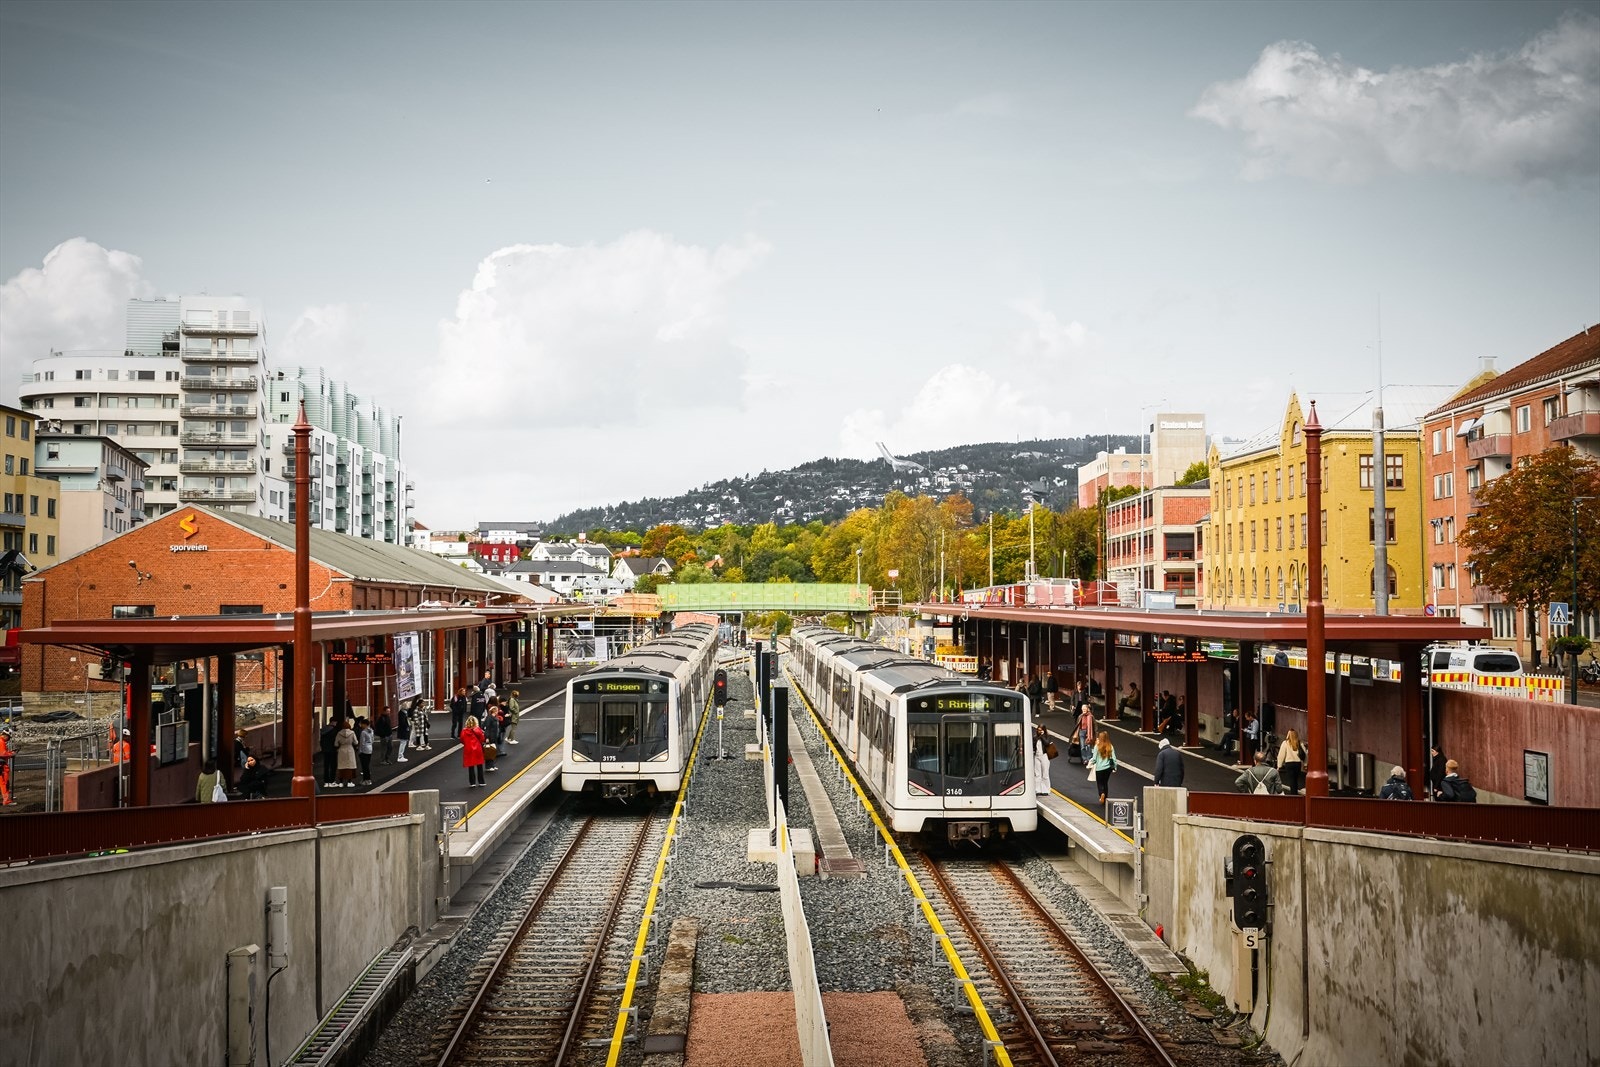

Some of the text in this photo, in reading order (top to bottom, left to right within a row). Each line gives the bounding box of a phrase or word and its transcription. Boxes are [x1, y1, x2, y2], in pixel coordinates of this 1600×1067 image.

[169, 543, 208, 553] sporveien
[597, 683, 640, 691] 5 Ringen
[937, 699, 989, 709] 5 Ringen
[1246, 935, 1255, 947] S
